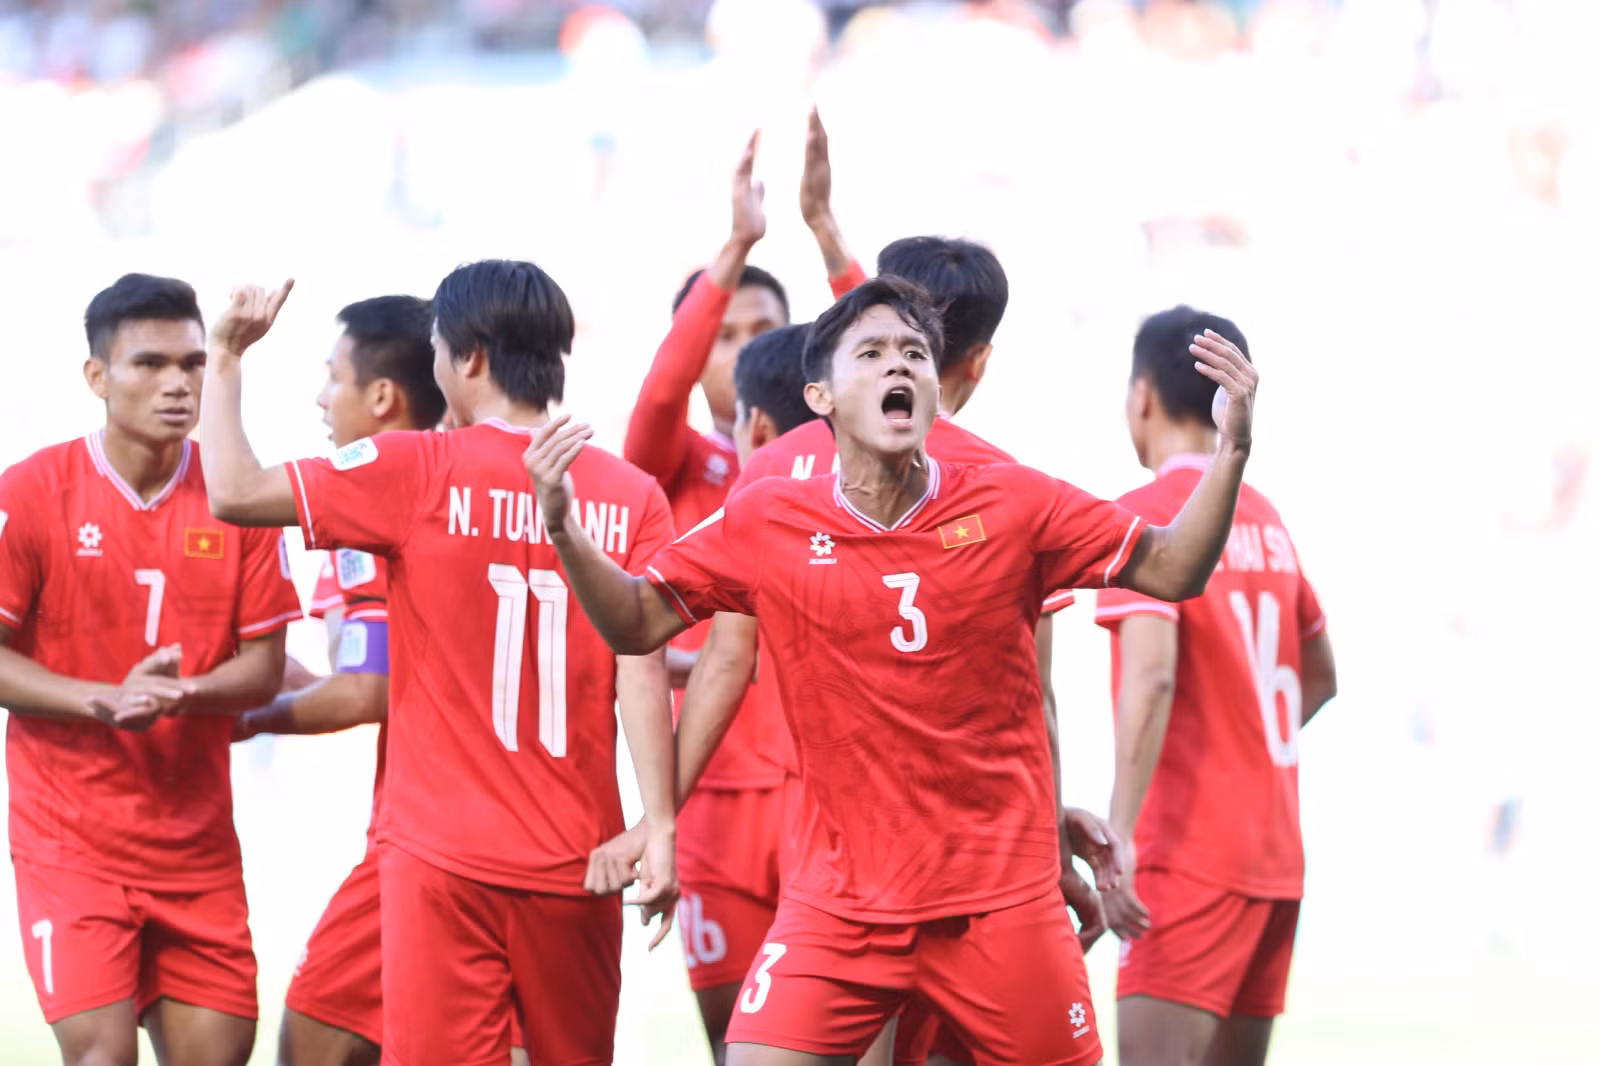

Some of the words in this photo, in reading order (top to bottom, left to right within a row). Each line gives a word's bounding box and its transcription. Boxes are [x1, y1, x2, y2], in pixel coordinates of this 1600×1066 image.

[448, 485, 479, 536] N.
[134, 569, 166, 647] 7
[882, 572, 928, 652] 3
[487, 562, 569, 758] 11
[1228, 590, 1303, 767] 16
[740, 942, 788, 1014] 3
